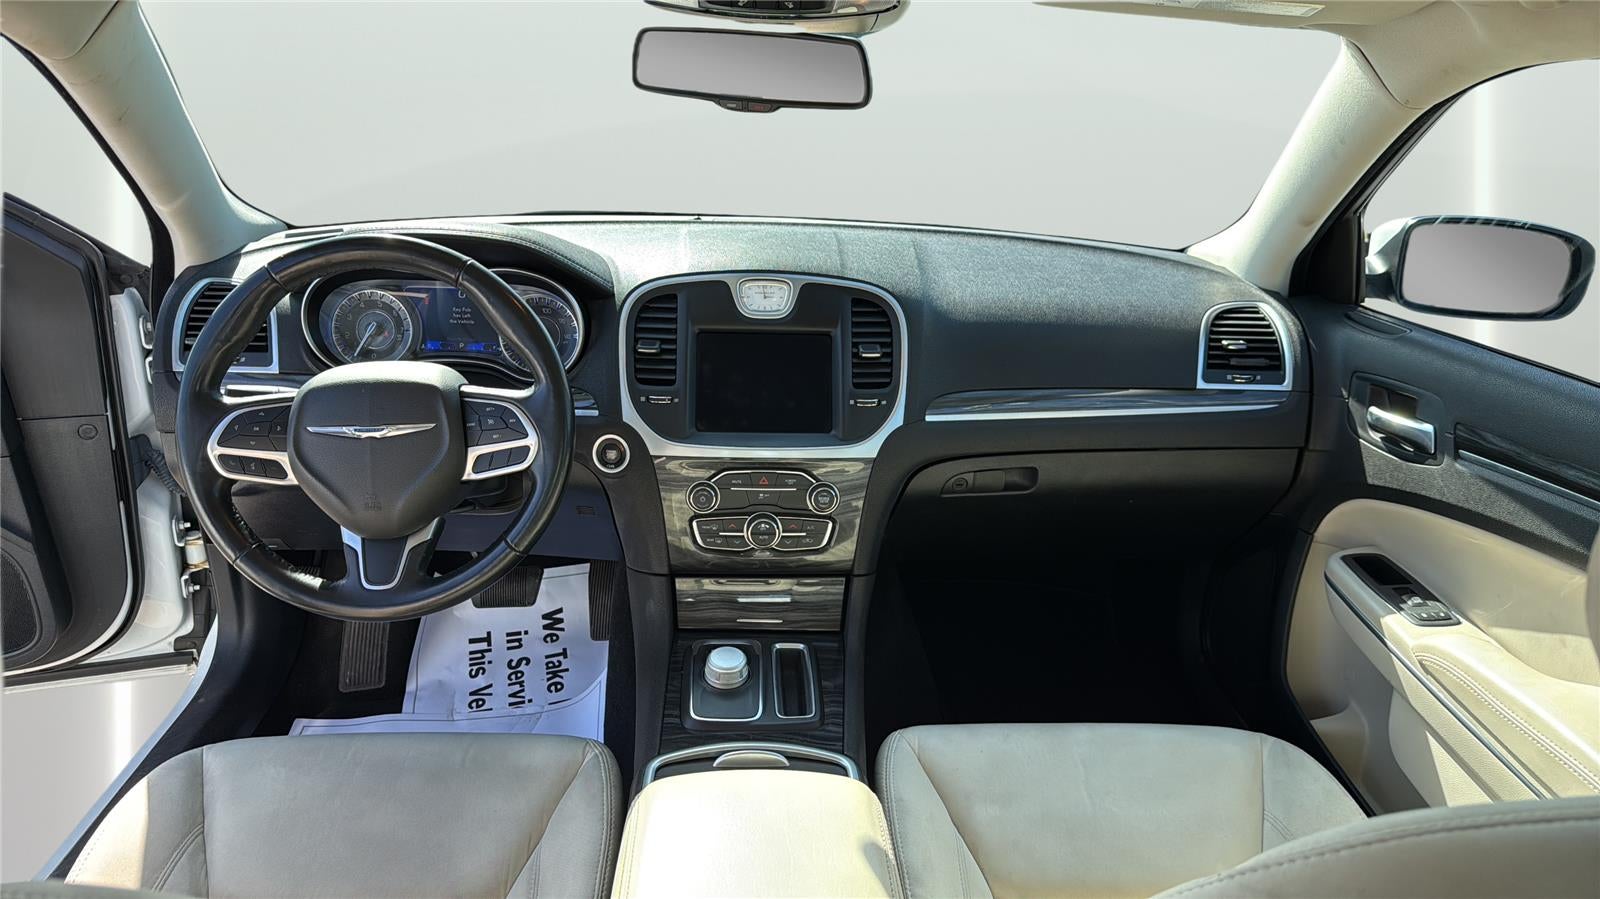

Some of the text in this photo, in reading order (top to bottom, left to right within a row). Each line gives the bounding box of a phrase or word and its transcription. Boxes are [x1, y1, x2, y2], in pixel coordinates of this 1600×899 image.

[542, 607, 565, 644] We
[468, 631, 493, 713] This Ve
[506, 630, 533, 708] in Servi
[544, 648, 570, 694] Take
